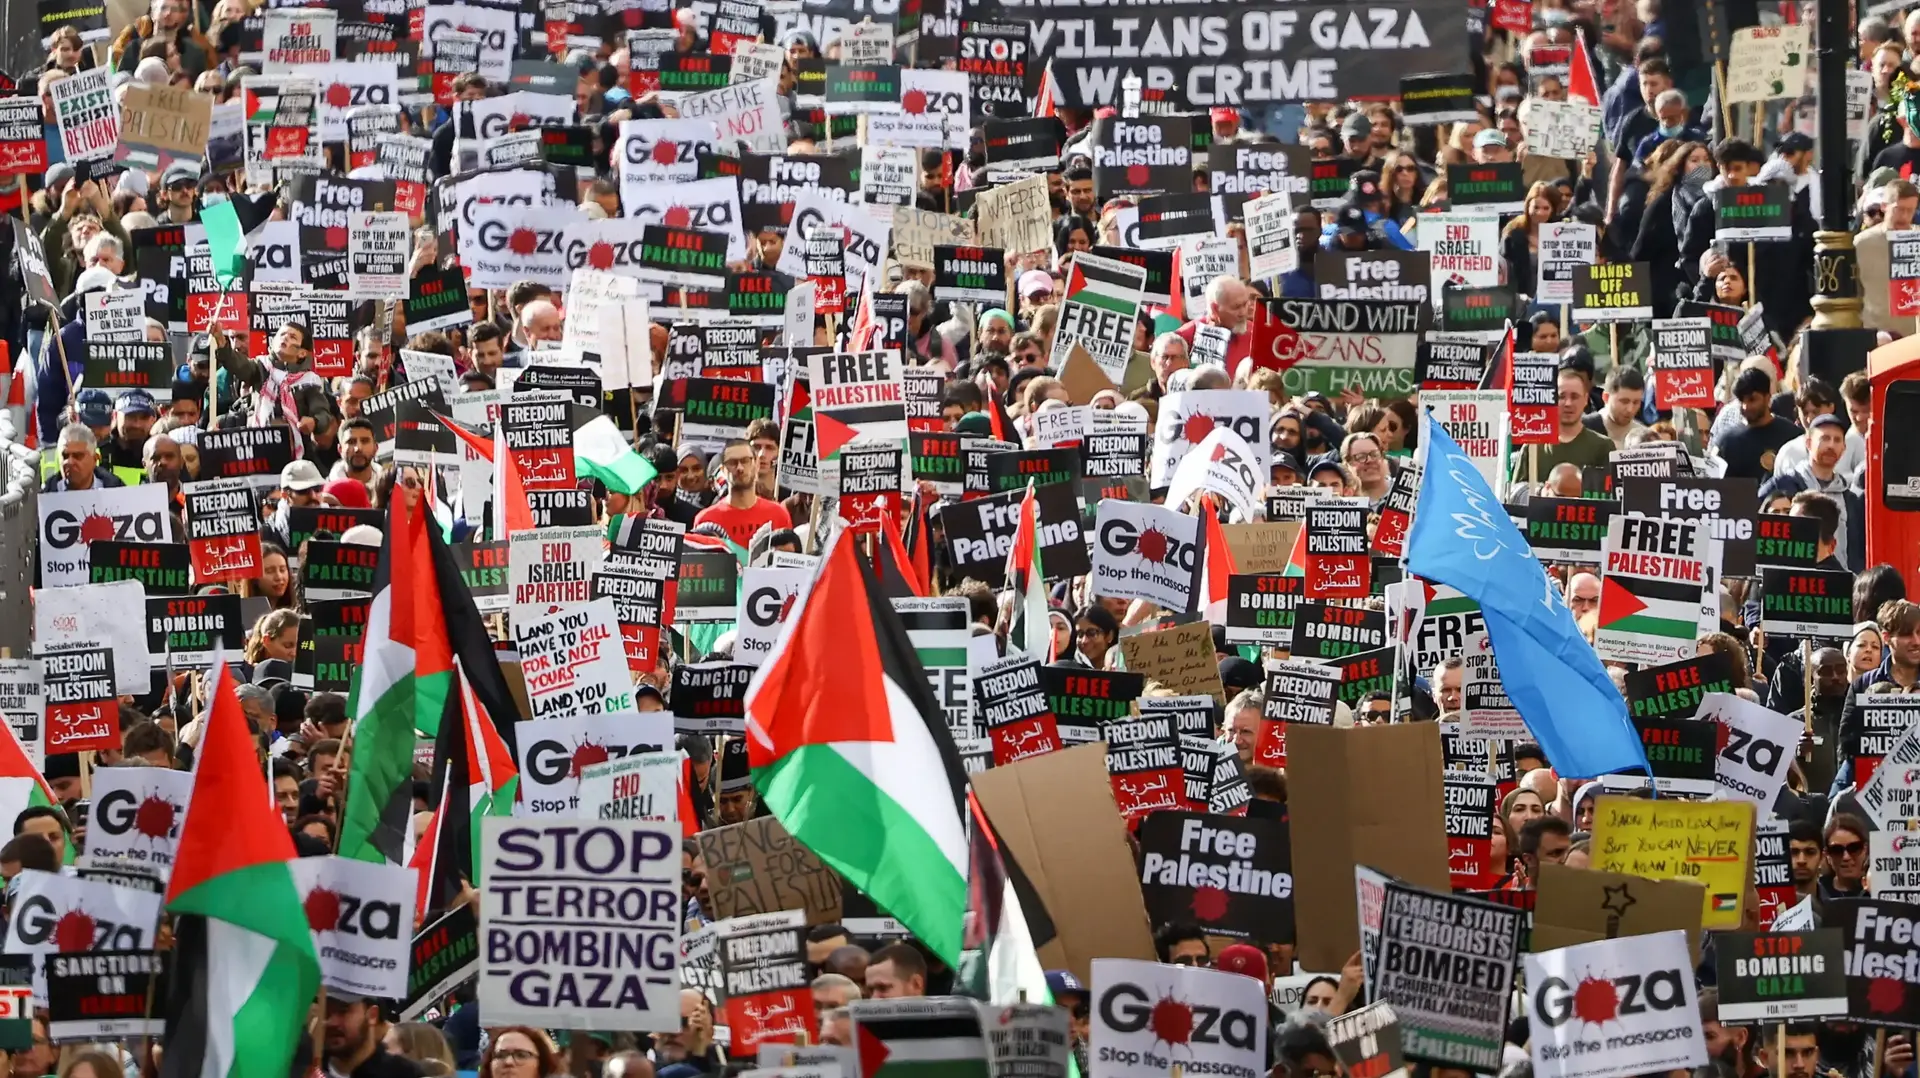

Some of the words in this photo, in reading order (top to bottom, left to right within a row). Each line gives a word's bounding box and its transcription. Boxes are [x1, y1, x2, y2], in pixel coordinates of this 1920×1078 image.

[290, 23, 312, 38] END
[279, 35, 321, 50] ISRAELI
[961, 37, 1025, 60] STOP
[269, 49, 331, 63] APARTHEID
[659, 71, 728, 86] PALESTINE
[1187, 59, 1337, 104] CRIME
[60, 89, 113, 115] EXIST!
[66, 118, 118, 156] RETURN!
[1114, 123, 1162, 144] Free
[1094, 145, 1188, 167] Palestine
[1237, 149, 1287, 169] Free
[769, 157, 820, 180] Free
[743, 179, 844, 204] Palestine
[1212, 171, 1310, 193] Palestine
[1454, 181, 1514, 194] PALESTINE
[315, 181, 363, 204] Free
[1720, 206, 1781, 218] PALESTINE
[352, 231, 373, 240] STOP
[376, 231, 388, 240] THE
[390, 231, 405, 240] WAR
[666, 232, 703, 250] FREE
[1447, 226, 1469, 240] END
[956, 248, 984, 259] STOP
[1542, 241, 1559, 250] STOP
[1562, 241, 1574, 250] THE
[1575, 241, 1592, 251] WAR
[642, 246, 724, 268] PALESTINE
[1185, 255, 1203, 265] STOP
[1204, 255, 1217, 264] THE
[1219, 254, 1235, 263] WAR
[478, 262, 499, 272] Stop
[504, 263, 520, 272] the
[944, 259, 997, 275] BOMBING
[1346, 258, 1400, 280] Free
[1590, 264, 1632, 279] HANDS
[1600, 279, 1623, 294] OFF
[1586, 291, 1639, 308] AL-AQSA
[90, 311, 109, 321] STOP
[111, 309, 124, 320] THE
[126, 308, 142, 318] WAR
[1060, 302, 1134, 343] FREE
[1659, 331, 1706, 347] FREEDOM
[89, 345, 164, 360] SANCTIONS
[1657, 350, 1709, 368] PALESTINE
[118, 359, 136, 372] ON
[822, 354, 890, 384] FREE
[1667, 373, 1702, 386] الحرية
[362, 376, 438, 416] SANCTIONS
[711, 385, 748, 401] FREE
[815, 383, 901, 405] PALESTINE
[508, 404, 566, 421] FREEDOM
[686, 399, 771, 420] PALESTINE
[1038, 410, 1082, 428] FREE
[1450, 404, 1476, 421] END
[204, 430, 282, 447] SANCTIONS
[506, 428, 571, 447] PALESTINE
[1089, 436, 1139, 453] FREEDOM
[923, 440, 957, 455] FREE
[846, 452, 896, 470] FREEDOM
[1019, 460, 1050, 472] FREE
[1086, 458, 1142, 476] PALESTINE
[1616, 462, 1670, 479] FREEDOM
[843, 474, 897, 492] PALESTINE
[193, 493, 248, 510] FREEDOM
[1660, 483, 1721, 510] Free
[1311, 511, 1360, 529] FREEDOM
[1556, 505, 1595, 522] FREE
[192, 518, 255, 538] PALESTINE
[1309, 535, 1364, 553] PALESTINE
[1621, 518, 1696, 558] FREE
[119, 549, 160, 568] FREE
[542, 544, 572, 562] END
[528, 562, 585, 581] ISRAELI
[1607, 552, 1702, 582] PALESTINE
[597, 579, 657, 598] FREEDOM
[1257, 578, 1297, 593] STOP
[1788, 578, 1827, 595] FREE
[168, 601, 206, 614] STOP
[894, 602, 928, 611] Solidarity
[930, 602, 966, 611] Campaign
[1765, 594, 1851, 616] PALESTINE
[153, 616, 224, 632] BOMBING
[1256, 610, 1294, 626] GAZA
[1324, 608, 1365, 624] STOP
[516, 621, 554, 642] LAND
[560, 611, 588, 630] YOU
[1305, 622, 1381, 644] BOMBING
[520, 639, 556, 659] HAVE
[559, 632, 576, 646] TO
[580, 623, 611, 648] KILL
[743, 637, 772, 651] Stop
[44, 653, 106, 674] FREEDOM
[523, 654, 550, 676] FOR
[554, 650, 566, 665] IS
[569, 642, 600, 662] NOT
[1466, 656, 1489, 668] STOP
[981, 667, 1038, 698] FREEDOM
[1476, 668, 1489, 678] ON
[1656, 666, 1700, 693] FREE
[0, 683, 14, 694] THE
[17, 683, 40, 696] WAR
[45, 680, 112, 701] PALESTINE
[712, 684, 732, 698] ON
[1066, 676, 1110, 698] FREE
[1272, 675, 1332, 699] FREEDOM
[1467, 685, 1480, 696] FOR
[1482, 686, 1487, 695] A
[54, 707, 101, 726] الحرية
[984, 692, 1048, 726] PALESTINE
[1264, 701, 1332, 724] PALESTINE
[1104, 719, 1170, 744] FREEDOM
[1642, 728, 1679, 745] FREE
[1105, 748, 1177, 772] PALESTINE
[613, 774, 640, 799] END
[1887, 788, 1912, 802] STOP
[1900, 804, 1914, 816] ON
[1180, 818, 1257, 858] Free
[494, 826, 674, 876] STOP
[765, 849, 821, 876] FOR
[1875, 857, 1903, 872] STOP
[1142, 852, 1293, 899] Palestine
[1891, 873, 1906, 886] ON
[489, 886, 677, 923] TERROR
[1391, 891, 1457, 922] ISRAELI
[1461, 908, 1514, 934] STATE
[416, 927, 449, 962] FREE
[727, 931, 798, 961] FREEDOM
[1388, 916, 1512, 960] TERRORISTS
[1754, 936, 1804, 957] STOP
[321, 944, 397, 971] massacre
[487, 929, 675, 974] BOMBING
[54, 955, 162, 978] SANCTIONS
[1384, 941, 1506, 992] BOMBED
[1735, 954, 1825, 977] BOMBING
[98, 976, 125, 996] ON
[727, 962, 806, 996] PALESTINE
[1756, 978, 1805, 996] GAZA
[509, 972, 650, 1011] GAZA
[744, 995, 794, 1020] الحرية
[1418, 1034, 1499, 1067] PALESTINE
[1099, 1046, 1140, 1065] Stop
[1144, 1050, 1168, 1068] the
[1172, 1057, 1256, 1078] massacre
